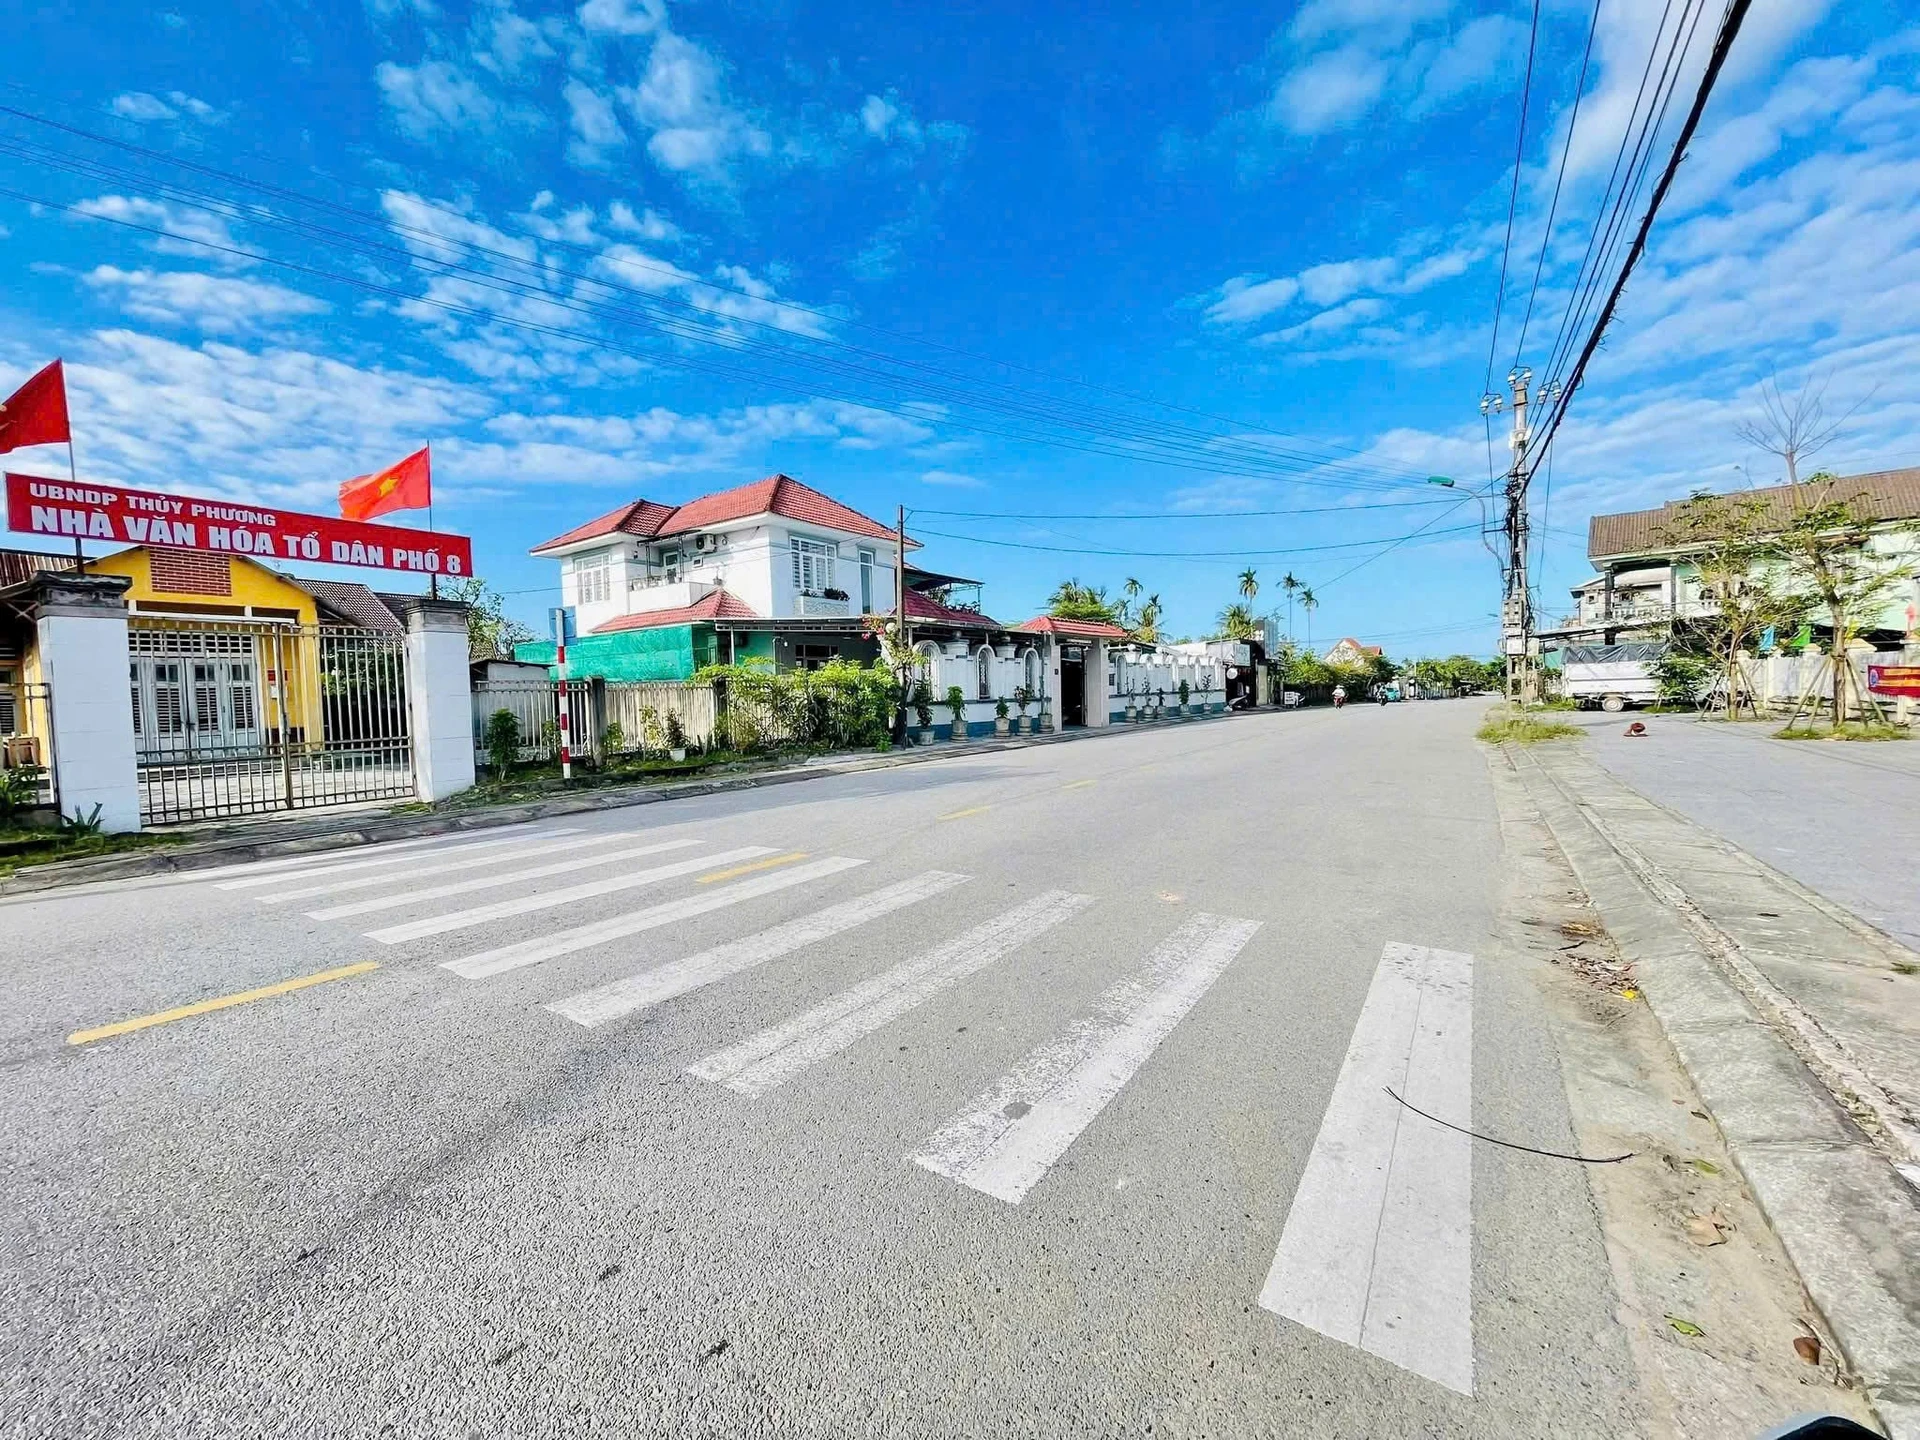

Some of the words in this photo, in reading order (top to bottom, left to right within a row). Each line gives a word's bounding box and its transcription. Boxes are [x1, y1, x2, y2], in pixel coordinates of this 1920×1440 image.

[29, 482, 118, 506] UBNDP
[125, 495, 190, 515] THỦY
[30, 505, 115, 538] NHÀ
[122, 515, 196, 546] VĂN
[208, 524, 276, 555] HÓA
[282, 531, 321, 559] TỔ
[331, 540, 384, 566] DÂN
[392, 545, 442, 571] PHỐ
[446, 554, 461, 574] 8
